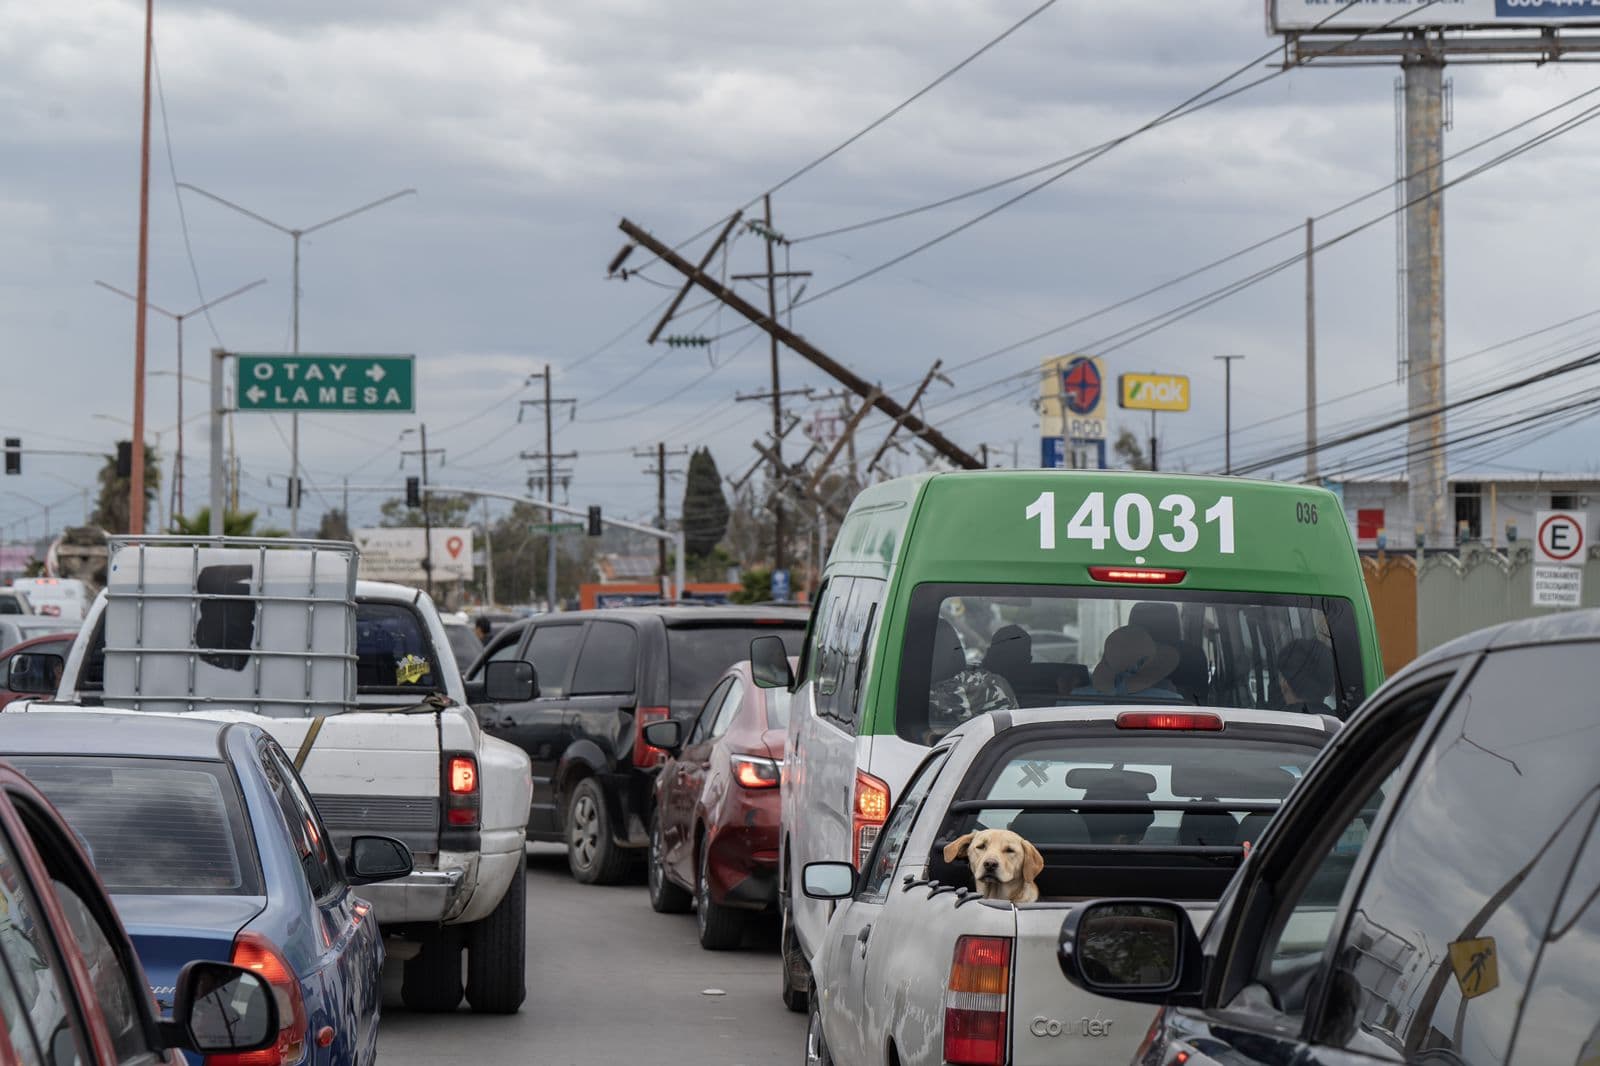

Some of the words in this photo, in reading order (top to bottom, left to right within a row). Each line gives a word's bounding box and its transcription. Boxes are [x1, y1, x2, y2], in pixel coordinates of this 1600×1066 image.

[253, 362, 347, 381] OTAY
[274, 386, 310, 404] LA
[319, 387, 401, 404] MESA
[1025, 491, 1235, 554] 14031
[1296, 502, 1318, 525] 036
[1551, 525, 1571, 550] E
